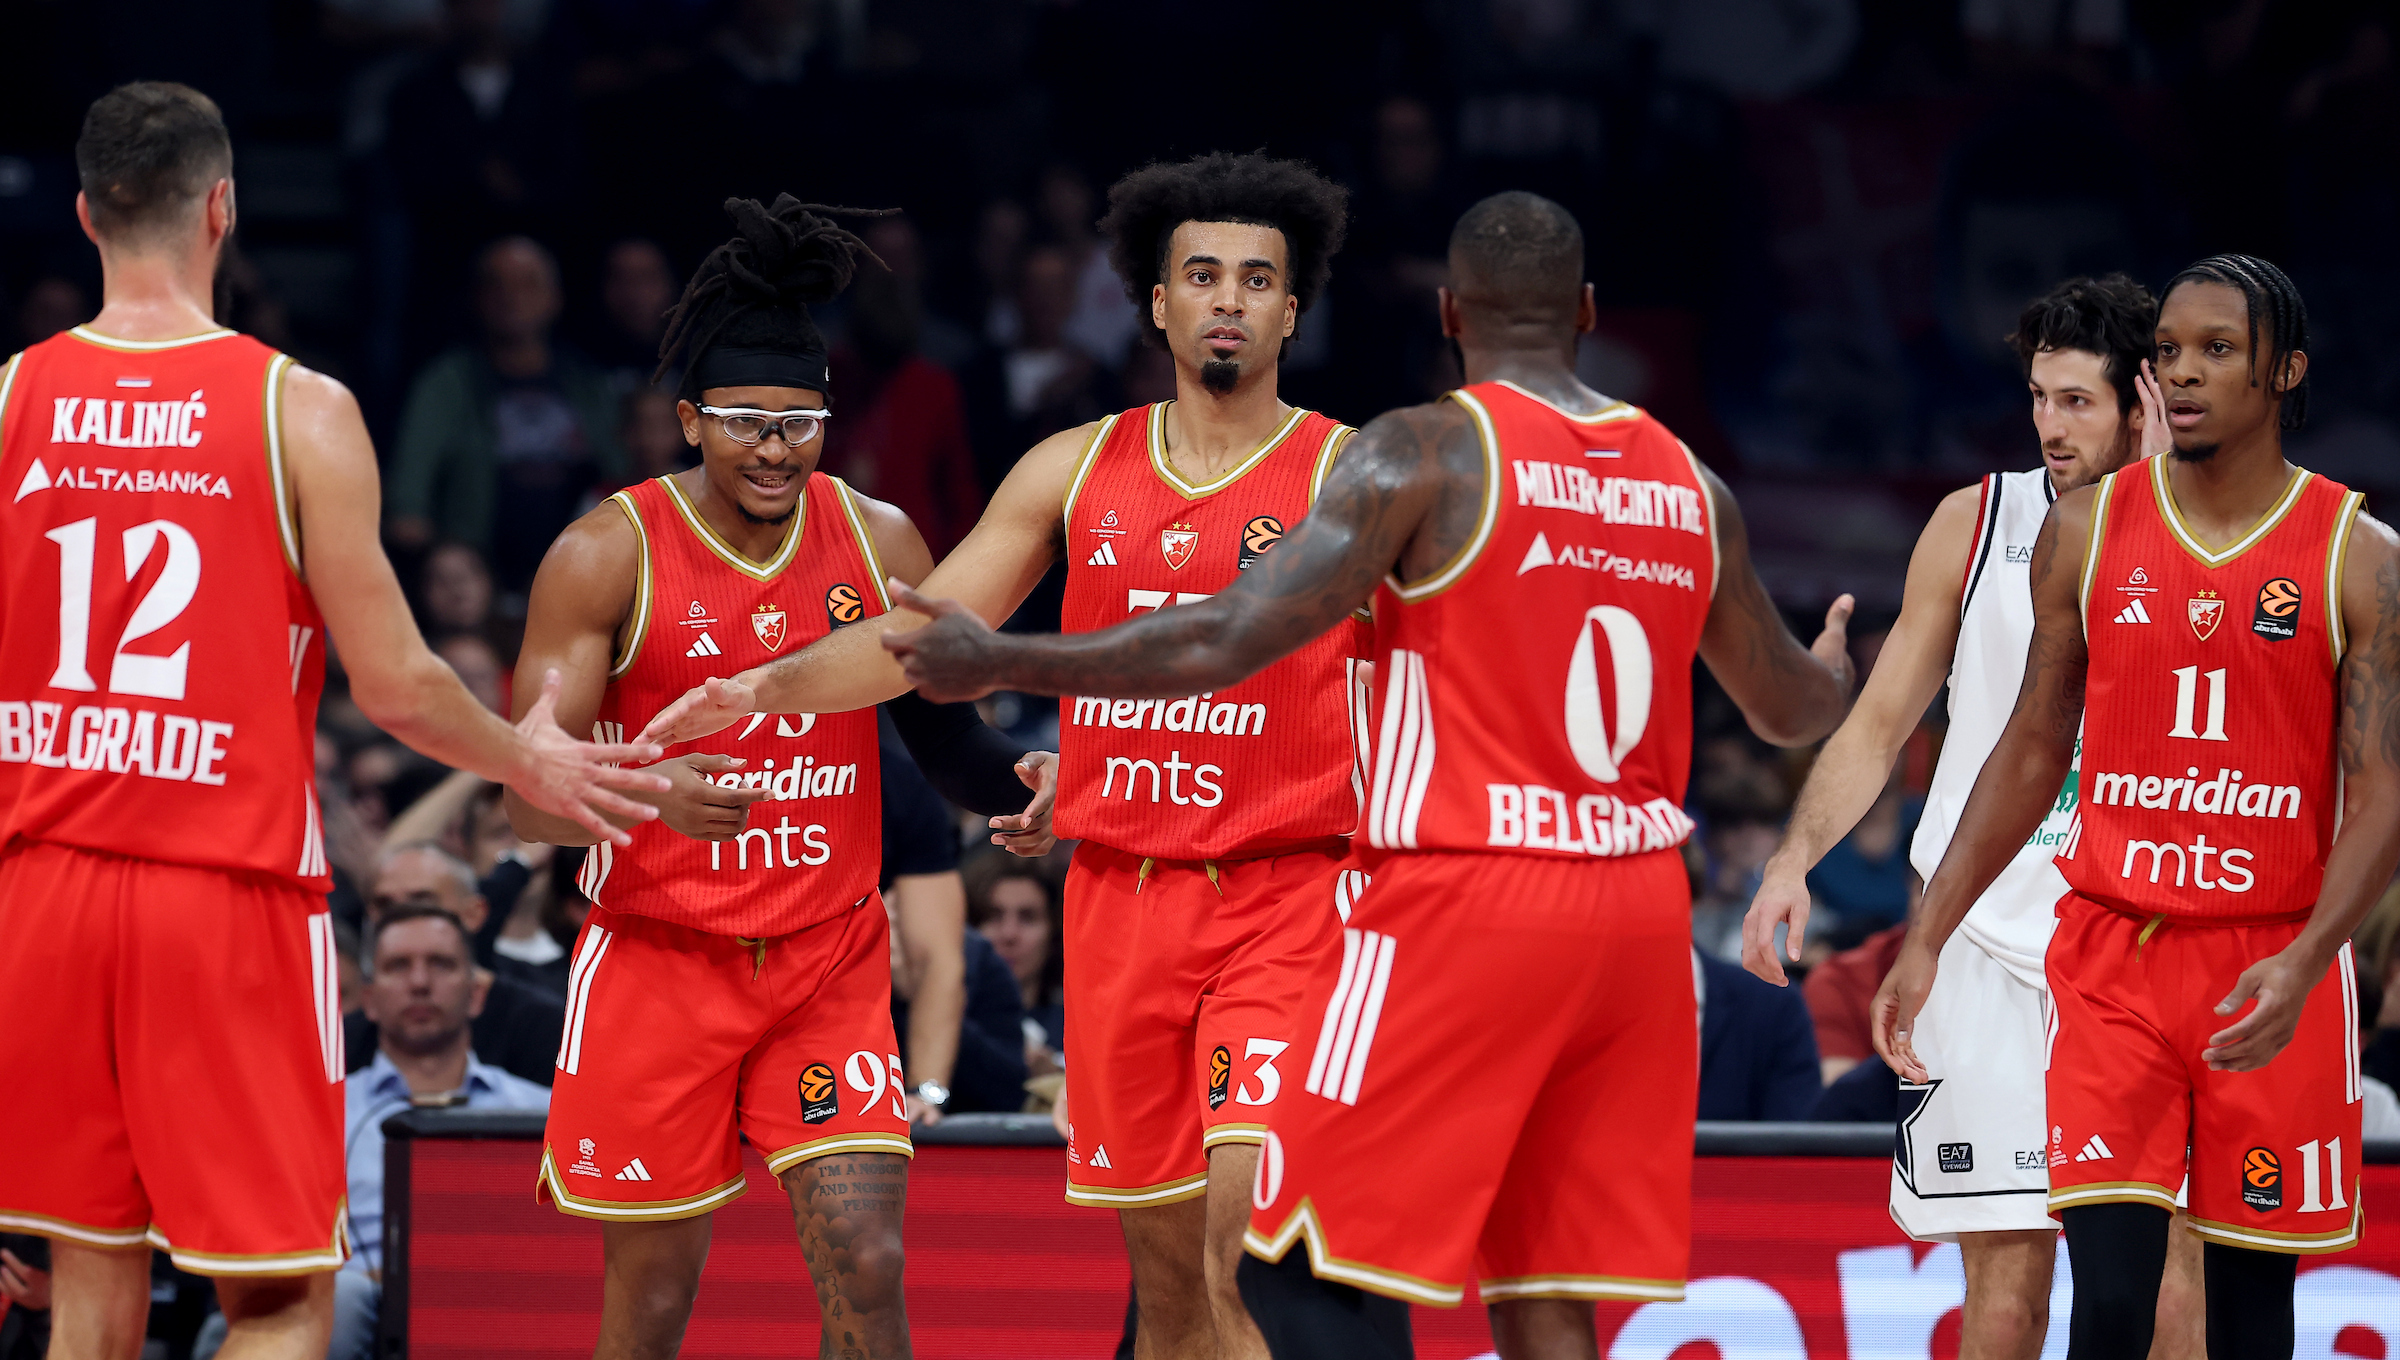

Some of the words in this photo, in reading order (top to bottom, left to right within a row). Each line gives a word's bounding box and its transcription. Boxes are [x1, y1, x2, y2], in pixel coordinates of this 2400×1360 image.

[50, 389, 206, 447] KALINIĆ
[54, 465, 233, 499] ALTABANKA
[2006, 545, 2034, 560] EA
[44, 516, 201, 701] 12
[1072, 691, 1267, 736] meridian
[1565, 604, 1654, 784] 0
[2167, 665, 2230, 742] 11
[0, 700, 234, 787] BELGRADE
[705, 755, 857, 802] eridian
[1101, 750, 1224, 808] mts
[2092, 765, 2302, 819] meridian
[2120, 834, 2255, 893] mts
[844, 1050, 908, 1122] 95
[846, 1163, 856, 1176] A
[1252, 1130, 1285, 1211] 0
[1940, 1145, 1969, 1160] EA7
[2296, 1136, 2348, 1213] 11
[819, 1183, 849, 1198] AND
[831, 1299, 844, 1321] 4
